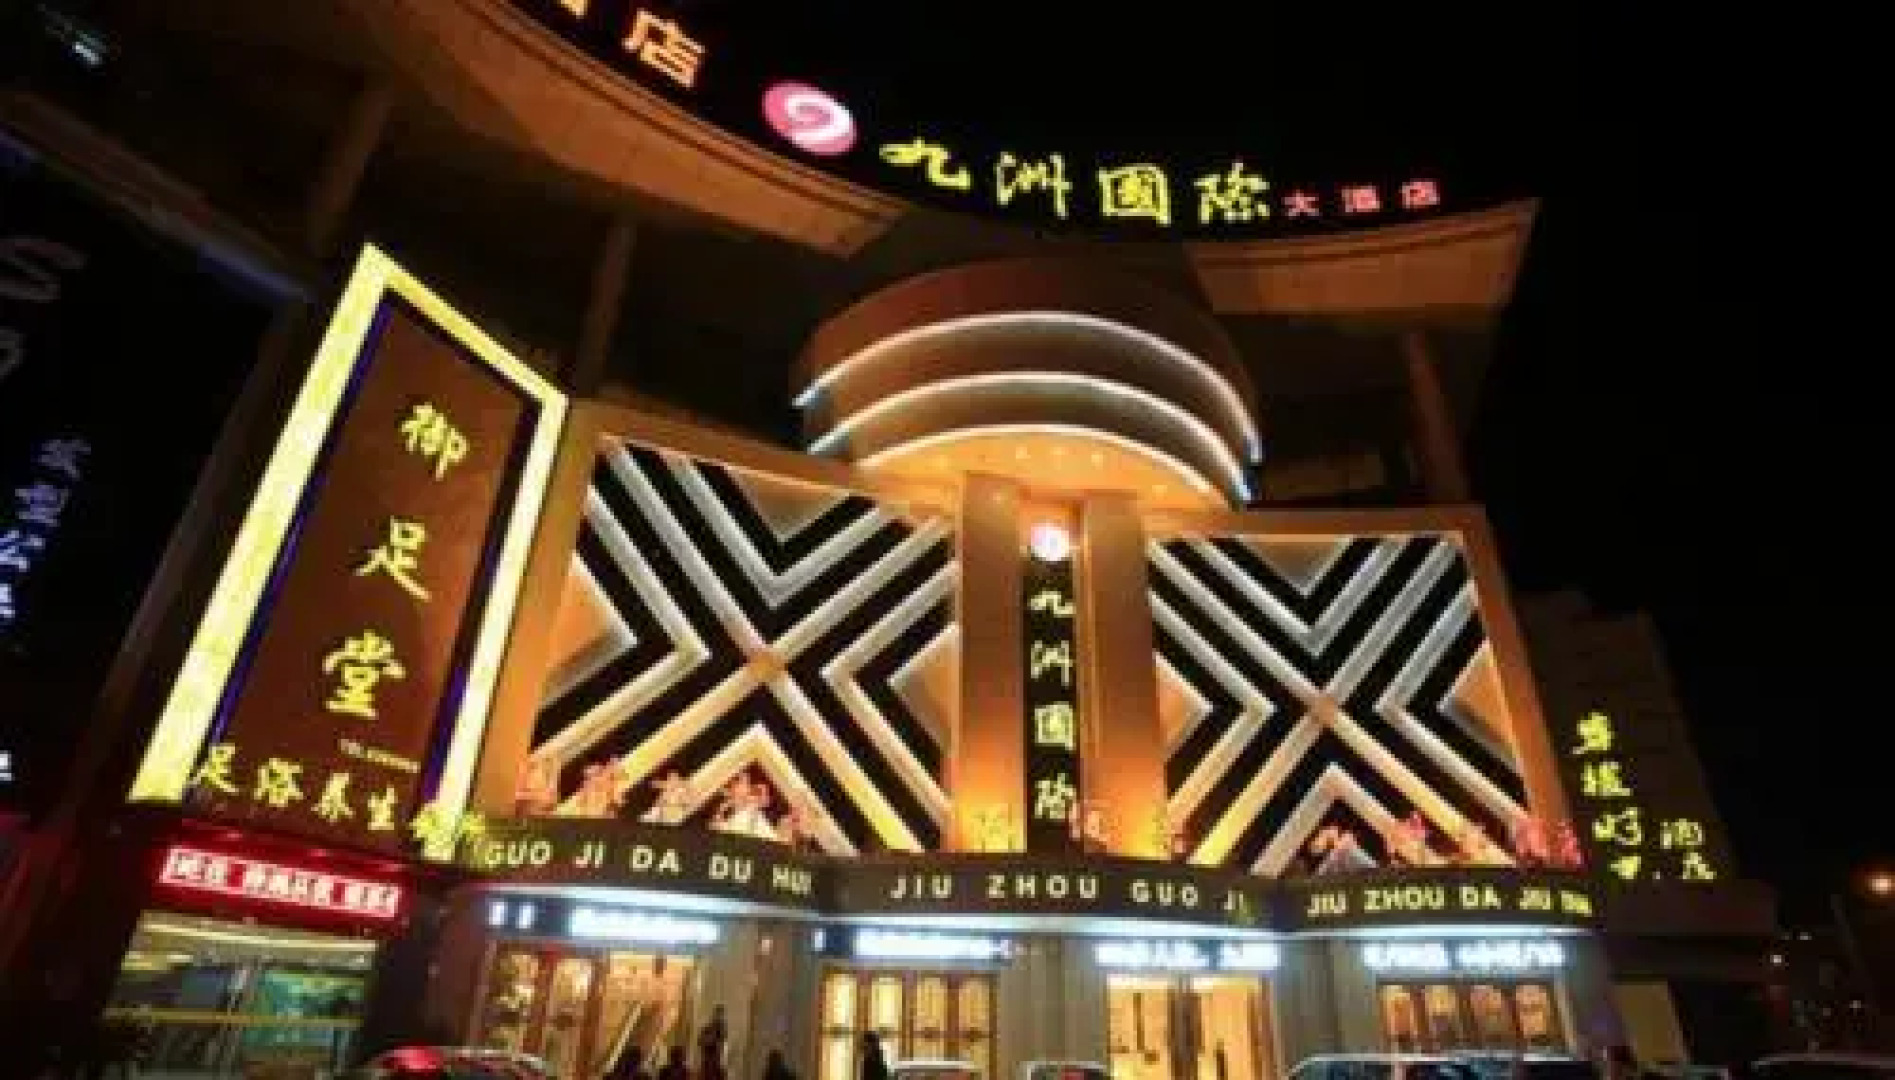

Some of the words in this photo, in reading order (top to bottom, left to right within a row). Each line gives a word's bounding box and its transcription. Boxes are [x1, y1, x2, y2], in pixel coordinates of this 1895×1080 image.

[878, 138, 1270, 226] 九洲國際
[322, 402, 470, 719] 御足堂
[1030, 590, 1077, 820] 九洲國際
[484, 840, 553, 867] GUO
[575, 840, 606, 868] JI
[631, 846, 682, 874] DA
[708, 855, 752, 883] DU
[890, 875, 953, 900] JIU
[985, 874, 1100, 900] ZHOU
[1129, 879, 1200, 907] GUO
[1363, 886, 1446, 911] ZHOU
[1458, 886, 1501, 911] DA
